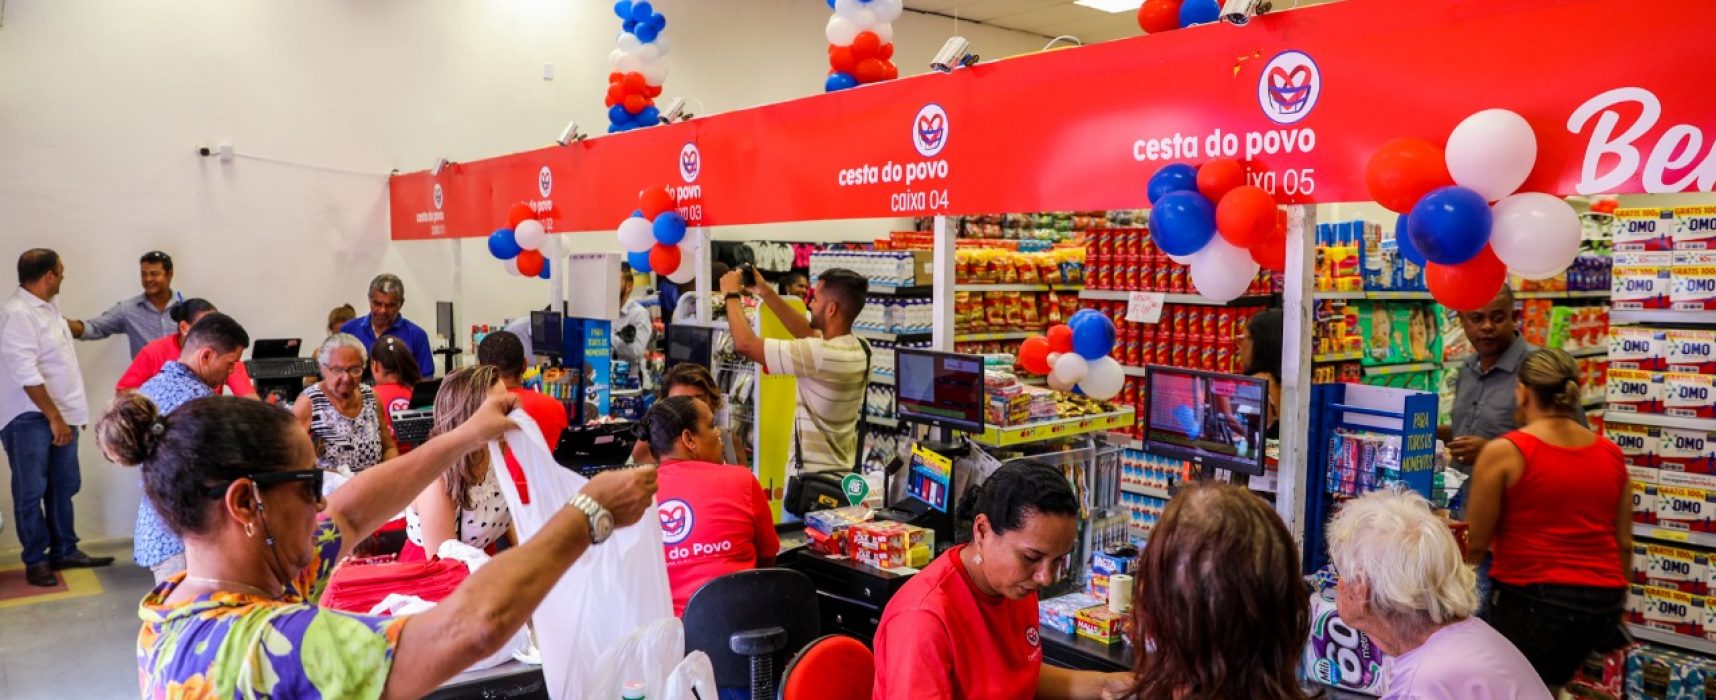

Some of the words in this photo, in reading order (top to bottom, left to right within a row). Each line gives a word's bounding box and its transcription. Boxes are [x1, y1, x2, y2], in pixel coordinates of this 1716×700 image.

[1133, 132, 1198, 161] cesta
[1205, 128, 1239, 157] do
[1245, 127, 1316, 161] povo
[1566, 86, 1716, 194] Be
[839, 163, 879, 186] cesta
[882, 160, 903, 182] do
[905, 159, 949, 186] povo
[1246, 167, 1276, 196] ixa
[1283, 168, 1315, 196] 05
[890, 188, 926, 212] caixa
[929, 188, 949, 210] 04
[689, 204, 702, 221] 03
[1628, 220, 1656, 233] OMO
[1626, 279, 1654, 292] OMO
[1687, 279, 1716, 292] OMO
[1624, 340, 1650, 352] OMO
[1682, 343, 1710, 356] OMO
[1621, 382, 1648, 395] OMO
[1680, 386, 1708, 400] OMO
[1412, 411, 1429, 430] PARA
[1407, 434, 1424, 452] TODOS
[1618, 435, 1644, 449] OMO
[1675, 436, 1704, 451] OMO
[1402, 454, 1434, 473] MOMENTOS
[1672, 499, 1701, 514] OMO
[669, 547, 689, 560] do
[692, 540, 732, 556] Povo
[1661, 559, 1690, 575] OMO
[1658, 601, 1687, 617] OMO
[1326, 616, 1363, 684] 60
